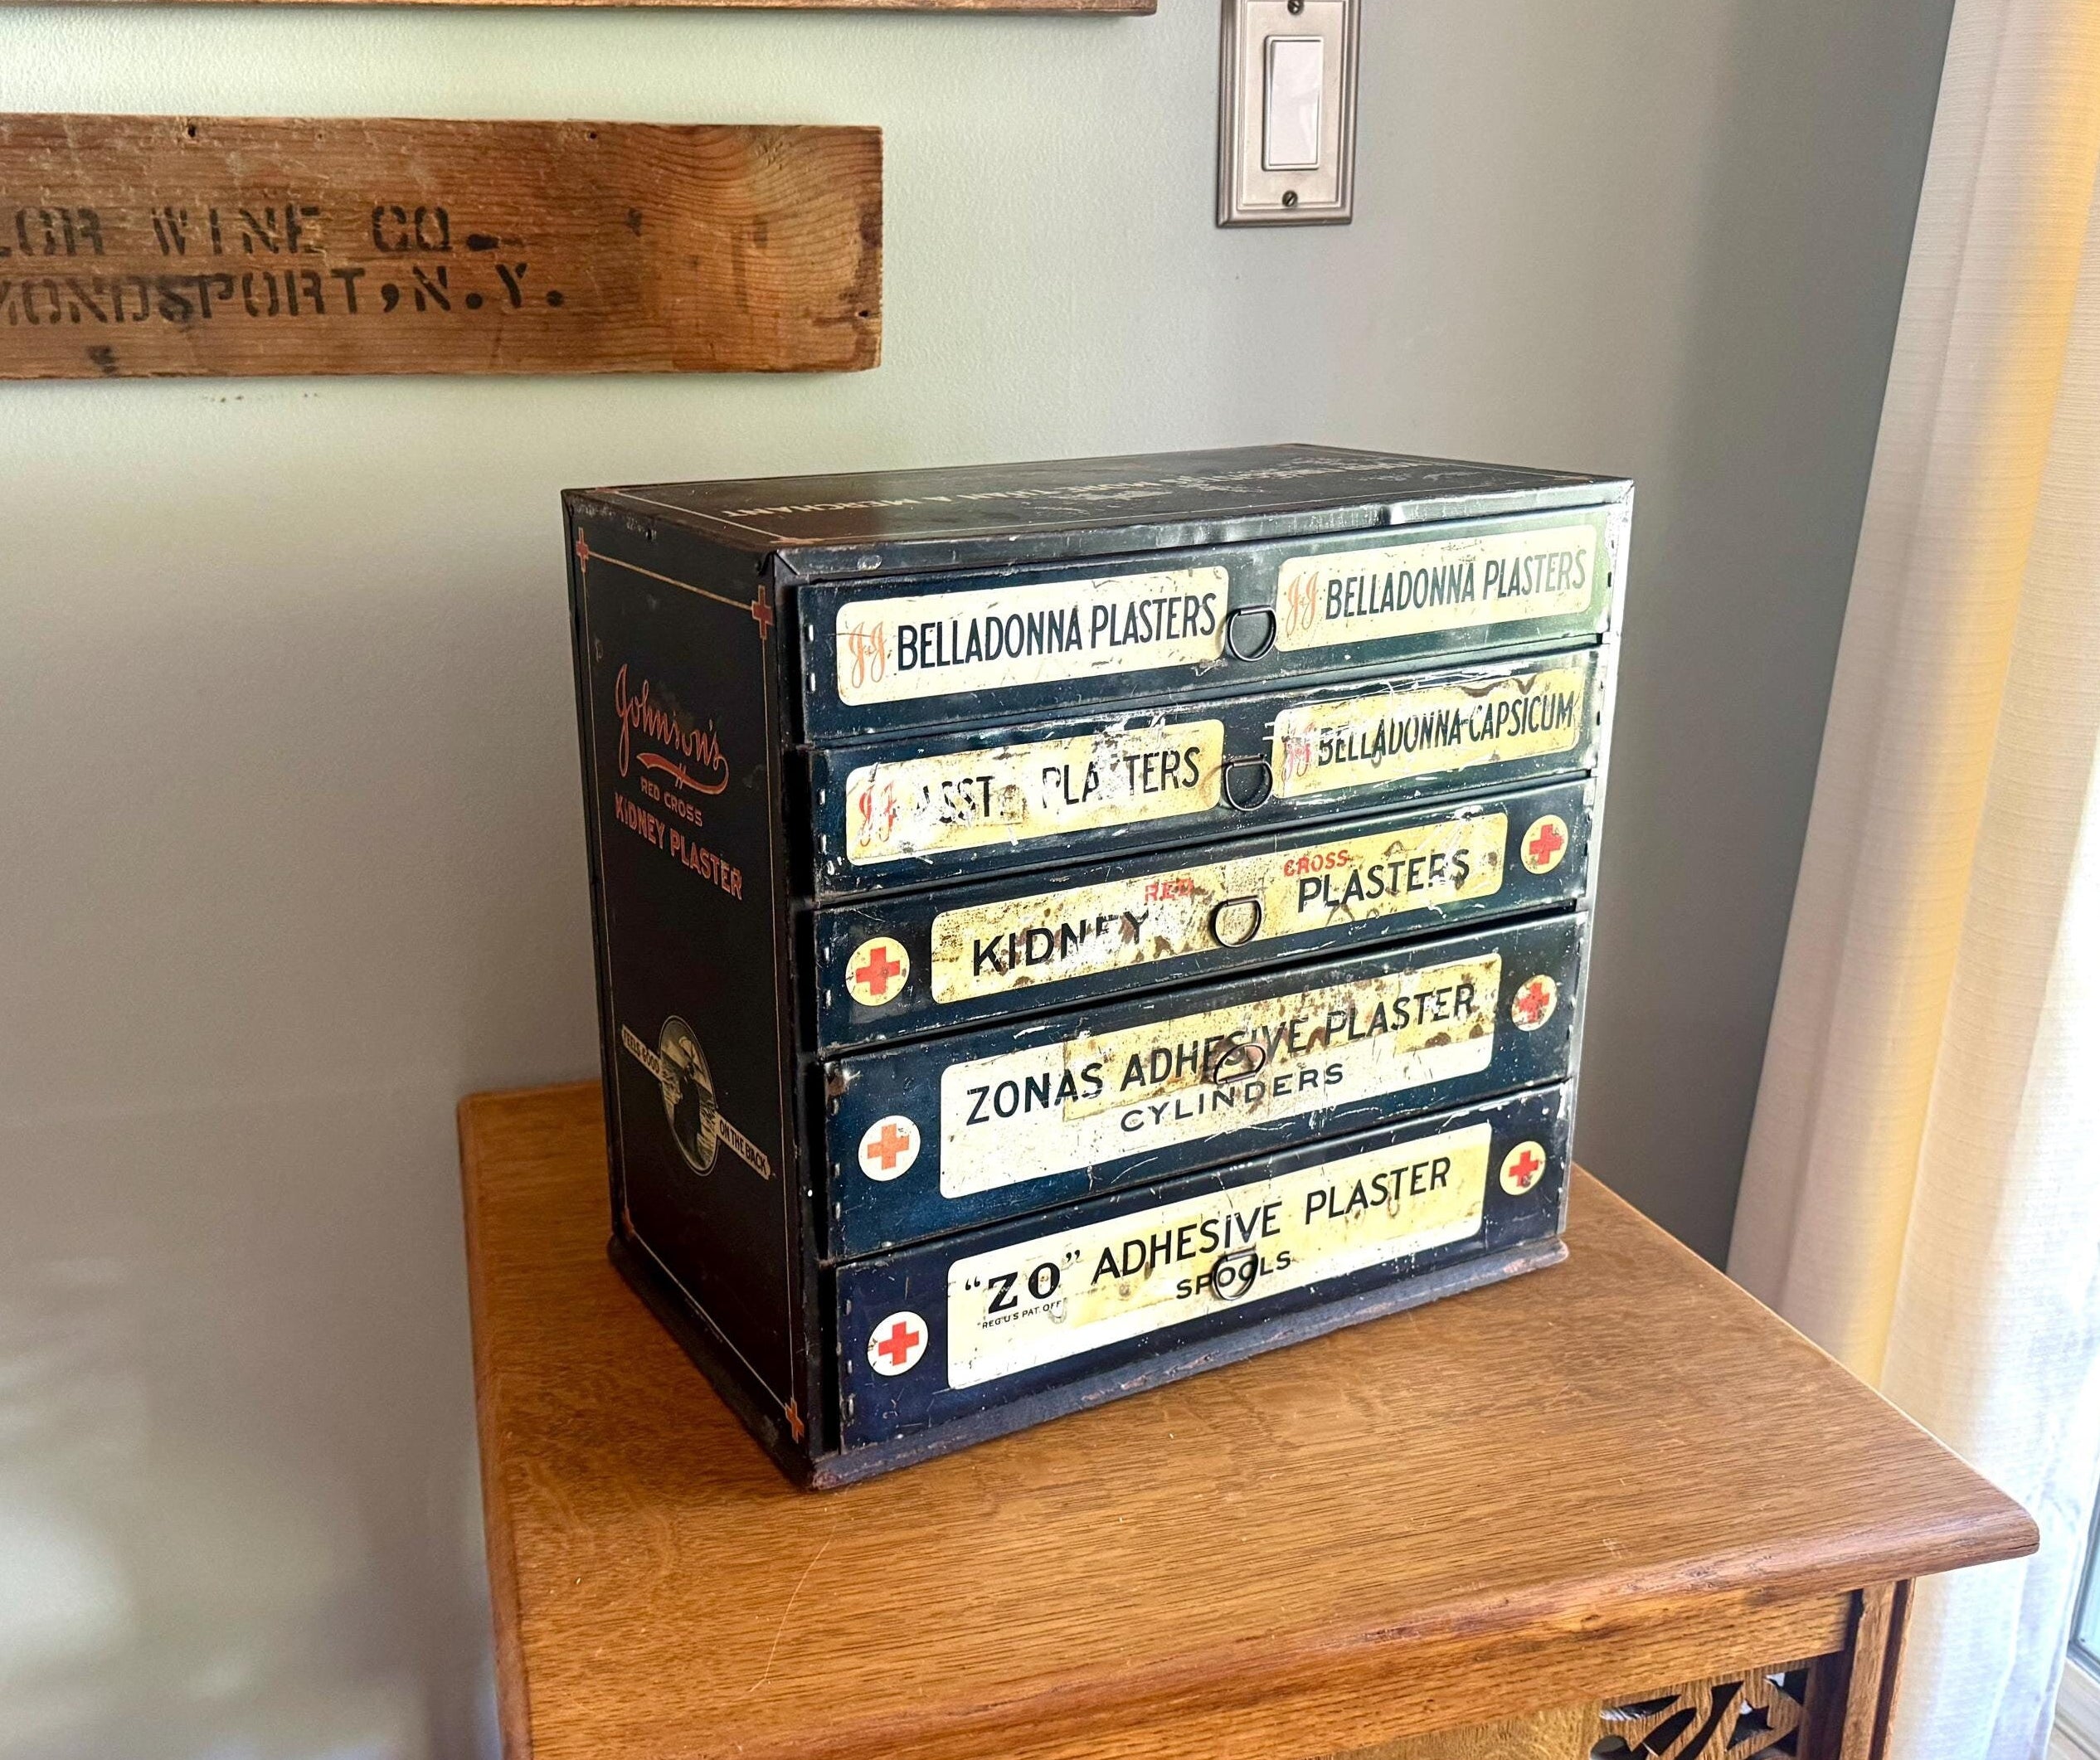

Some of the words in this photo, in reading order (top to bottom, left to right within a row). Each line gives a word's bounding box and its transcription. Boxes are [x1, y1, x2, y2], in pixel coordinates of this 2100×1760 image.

[0, 207, 104, 256] OR
[151, 202, 321, 254] WINE
[722, 498, 923, 517] MERCHANT
[956, 489, 1062, 499] THAN
[1054, 481, 1161, 493] MORE
[1325, 562, 1475, 620] BELLADONNA
[1482, 549, 1587, 600] PLASTERS
[897, 607, 1082, 672] BELLADONNA
[1091, 592, 1218, 649] PLASTERS
[615, 663, 728, 778] Johnson's
[1318, 708, 1461, 766] BELLADONNA
[1468, 691, 1575, 742] CAPSICUM
[639, 775, 661, 802] RED
[664, 790, 703, 828] CROSS
[1041, 746, 1201, 810] PLATERS
[615, 791, 666, 850] KIDNEY
[670, 827, 743, 902] PLASTER
[1145, 878, 1194, 902] RED
[1283, 849, 1349, 877] CROSS
[972, 909, 1150, 976] KIDNEY
[1298, 848, 1470, 913] PLASTERS
[965, 1062, 1105, 1126] ZONAS
[1325, 982, 1475, 1045] PLASTER
[1120, 1062, 1344, 1132] CYLINDERS
[719, 1119, 731, 1141] ON
[731, 1126, 746, 1153] THE
[746, 1140, 767, 1175] BACK
[1091, 1200, 1283, 1286] ADHESIVE
[1305, 1155, 1451, 1225] PLASTER
[1175, 1250, 1292, 1300] SPOOLS
